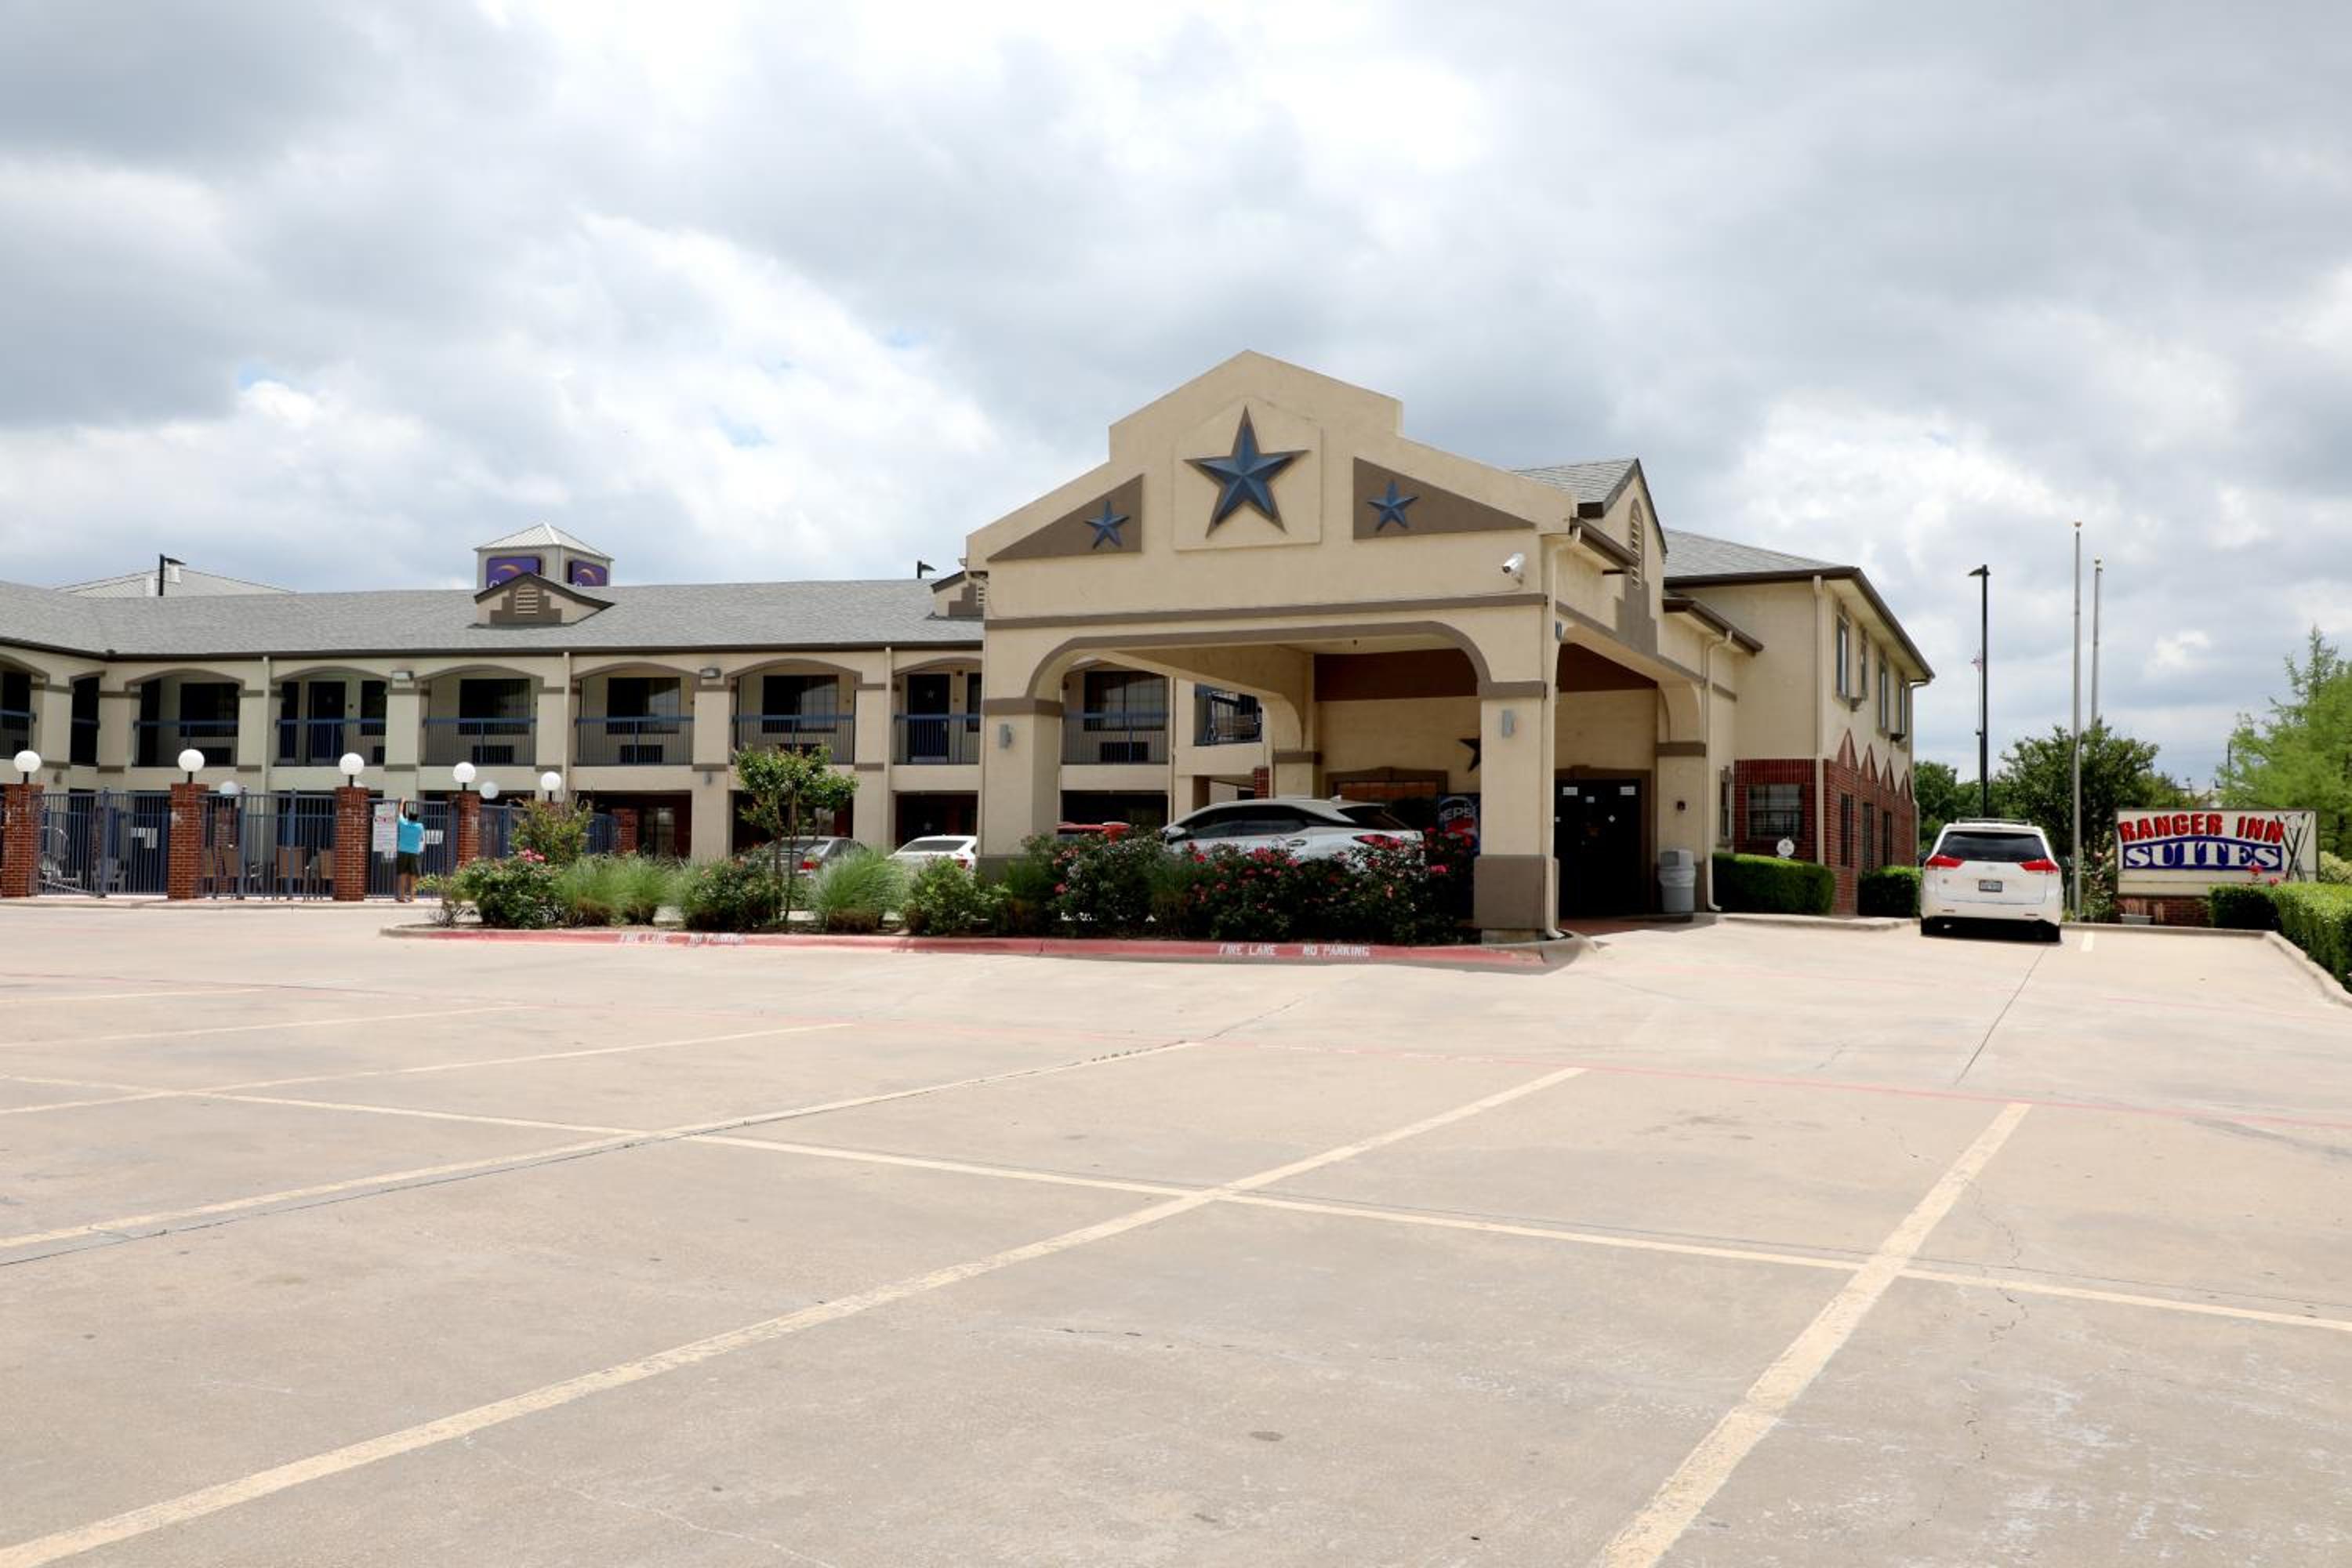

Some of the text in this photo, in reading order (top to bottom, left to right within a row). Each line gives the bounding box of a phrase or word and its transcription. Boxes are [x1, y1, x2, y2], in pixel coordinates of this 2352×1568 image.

[2118, 814, 2284, 844] RANGER INN
[2125, 841, 2280, 867] SUITES
[1219, 942, 1370, 957] FIRE LANE NO PARKING
